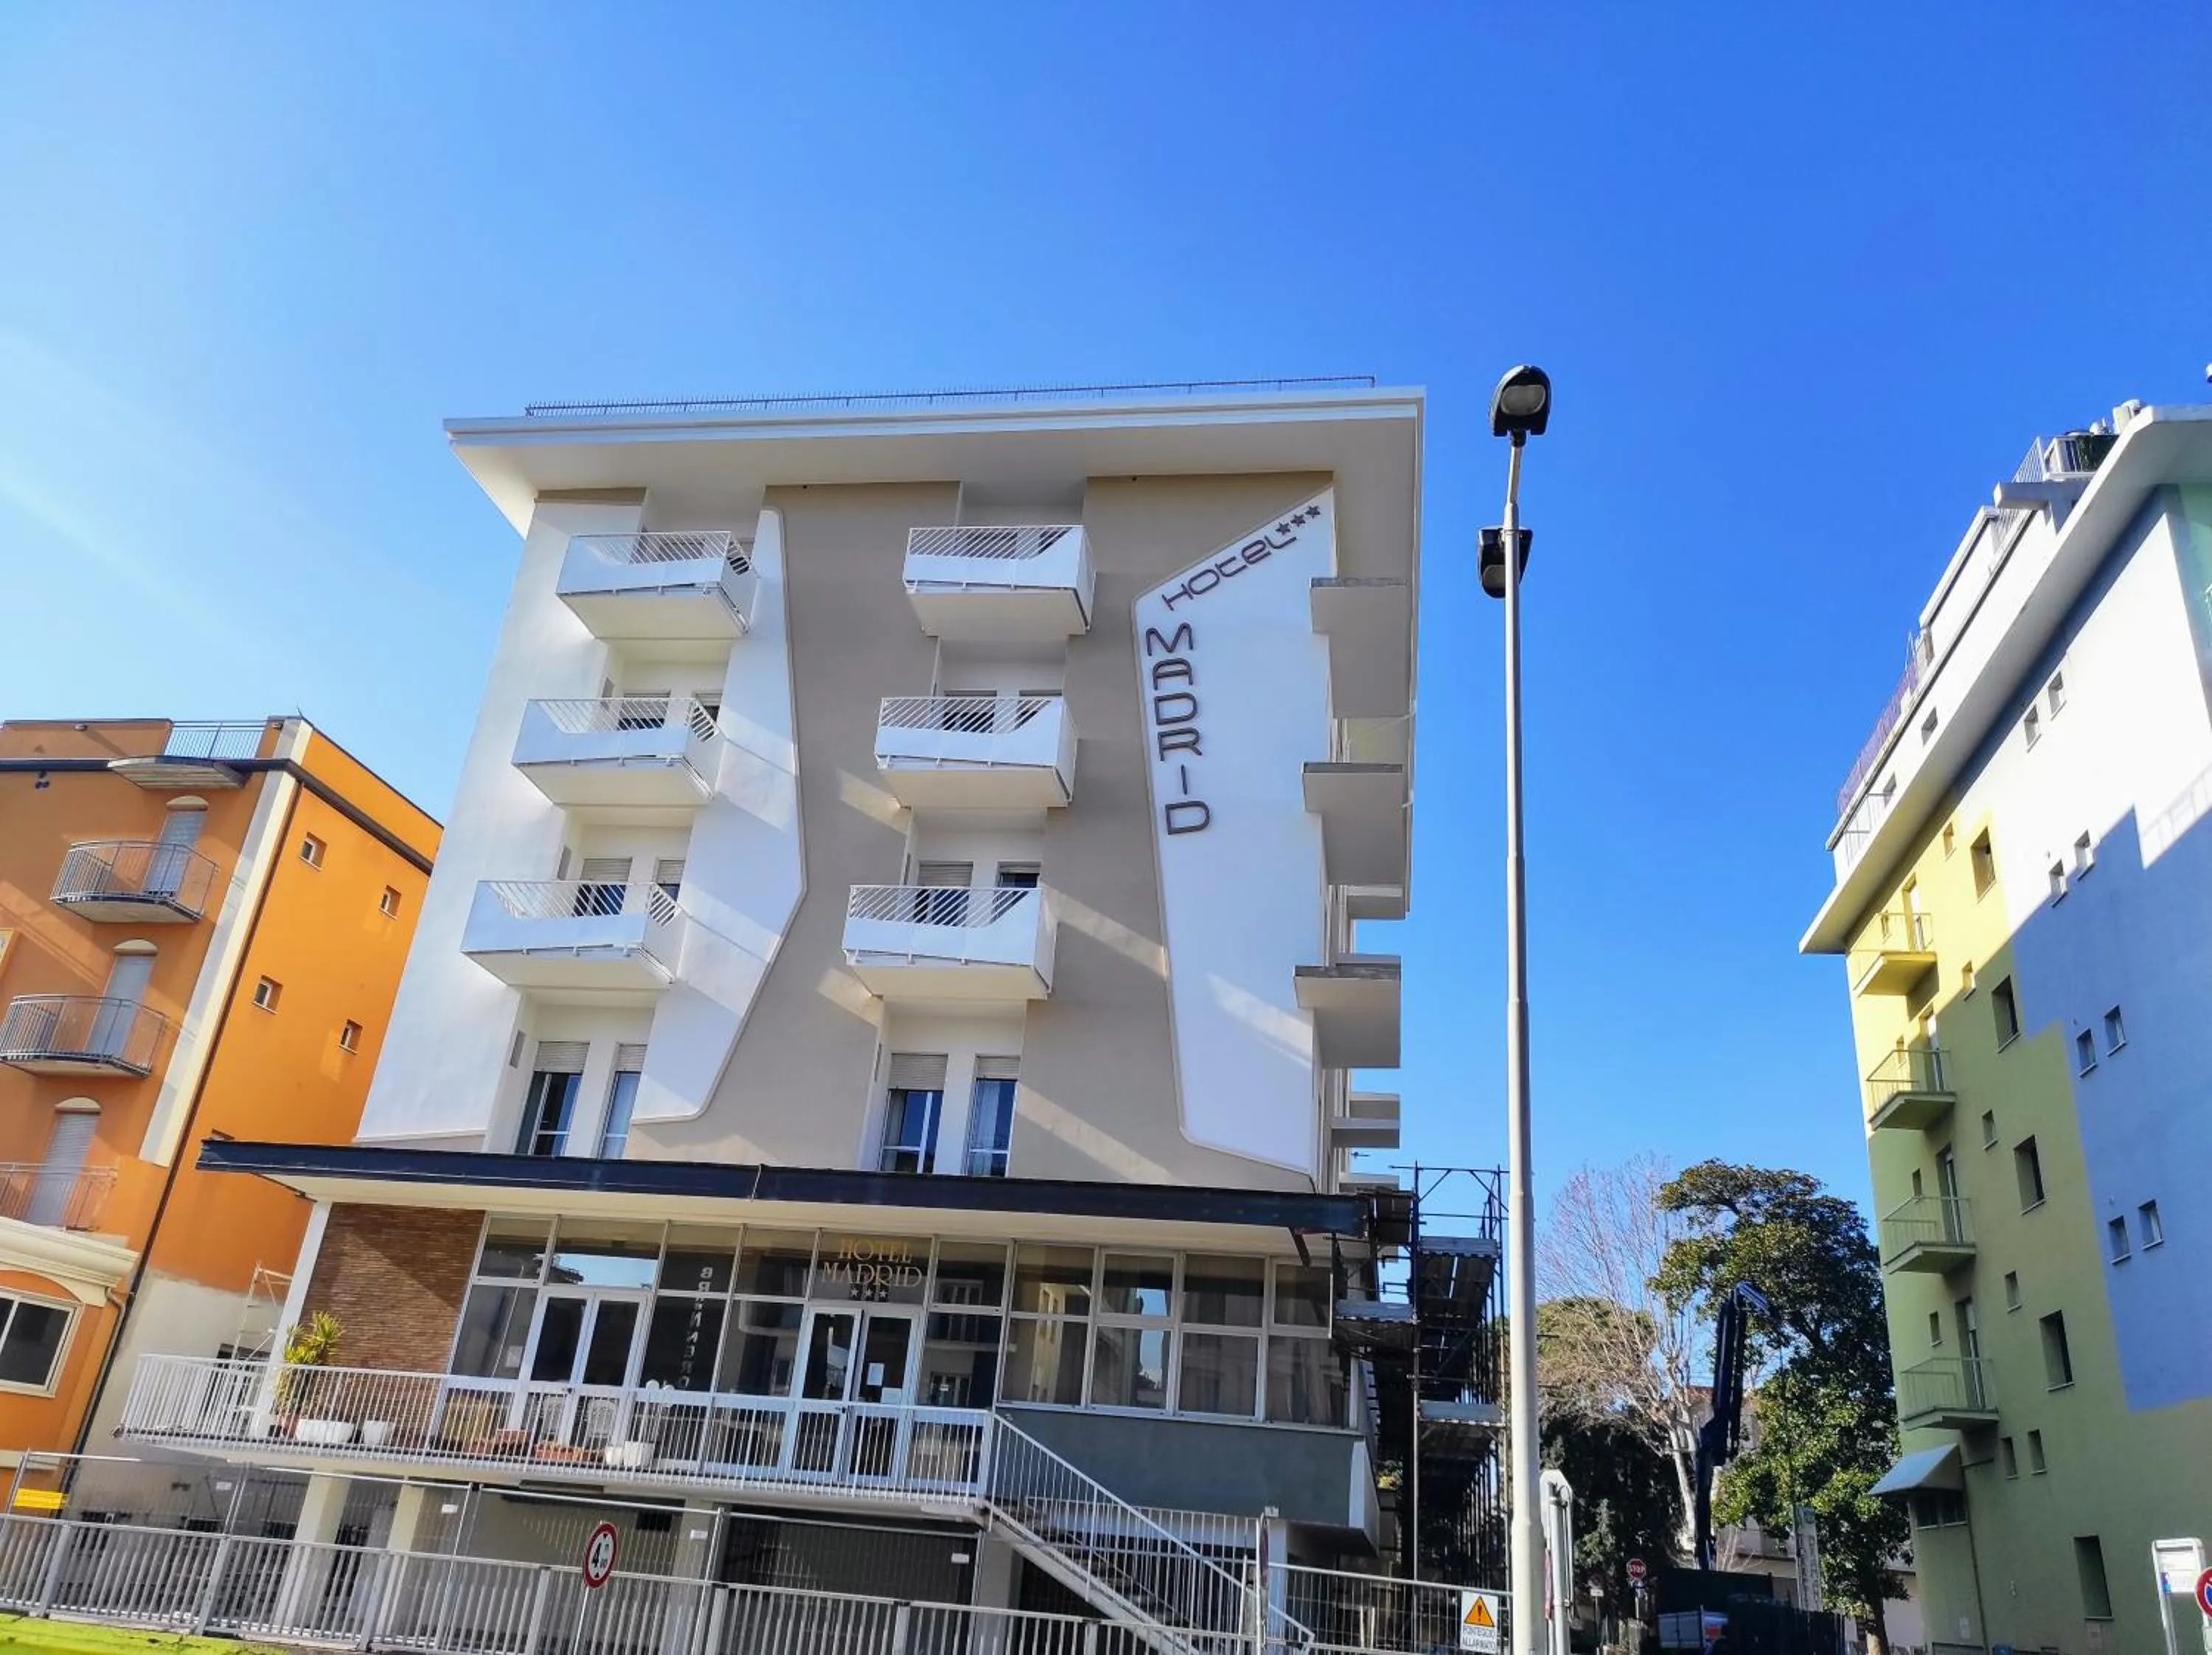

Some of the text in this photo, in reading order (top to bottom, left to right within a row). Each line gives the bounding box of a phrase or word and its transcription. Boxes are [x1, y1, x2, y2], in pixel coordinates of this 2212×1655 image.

[1145, 622, 1211, 836] MADRID
[838, 1238, 913, 1264] HOTEL
[822, 1261, 923, 1288] MADRID
[1629, 1564, 1645, 1573] STOP
